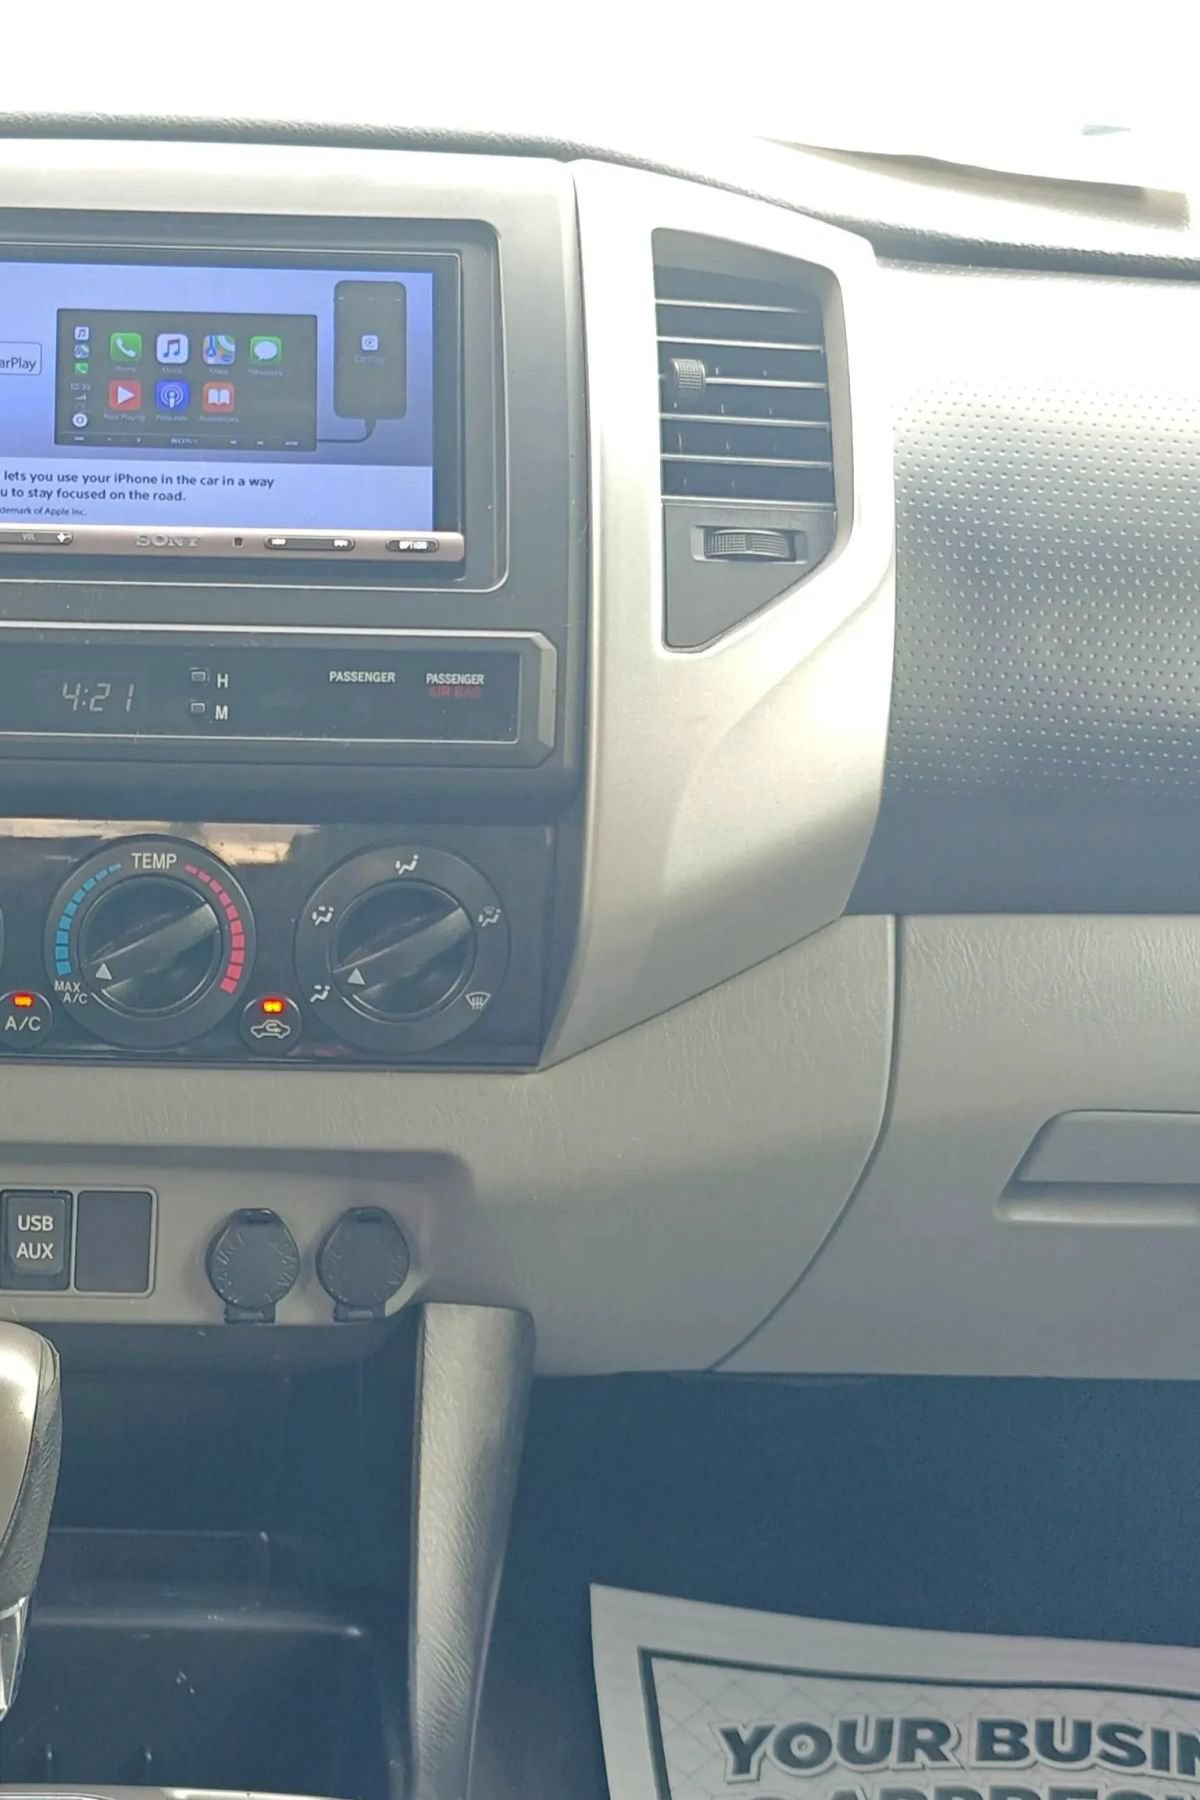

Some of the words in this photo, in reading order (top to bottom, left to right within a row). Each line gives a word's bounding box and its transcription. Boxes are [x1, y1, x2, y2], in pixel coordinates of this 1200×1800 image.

[4, 470, 27, 482] lets
[30, 473, 53, 485] you
[57, 473, 78, 483] use
[82, 474, 111, 486] your
[114, 473, 158, 485] iPhone
[161, 473, 173, 485] in
[176, 474, 197, 486] the
[200, 477, 218, 487] car
[222, 475, 235, 487] in
[237, 478, 245, 487] a
[249, 478, 275, 490] way
[11, 487, 24, 498] to
[28, 488, 53, 501] stay
[56, 487, 106, 500] focused
[110, 491, 125, 501] on
[129, 490, 150, 501] the
[152, 491, 187, 502] road.
[34, 506, 43, 515] of
[44, 507, 70, 518] Apple
[72, 508, 87, 517] Inc.
[135, 535, 201, 548] SONY
[216, 673, 230, 689] H
[328, 670, 397, 683] PASSENGER
[425, 672, 485, 685] PASSENGER
[61, 682, 135, 712] 4:21
[214, 704, 230, 721] M
[131, 852, 178, 870] TEMP
[54, 979, 82, 993] MAX
[62, 992, 89, 1005] A/C
[4, 1015, 41, 1032] A/C
[16, 1214, 55, 1232] USB
[15, 1242, 55, 1260] AUX
[720, 1717, 951, 1777] YOUR
